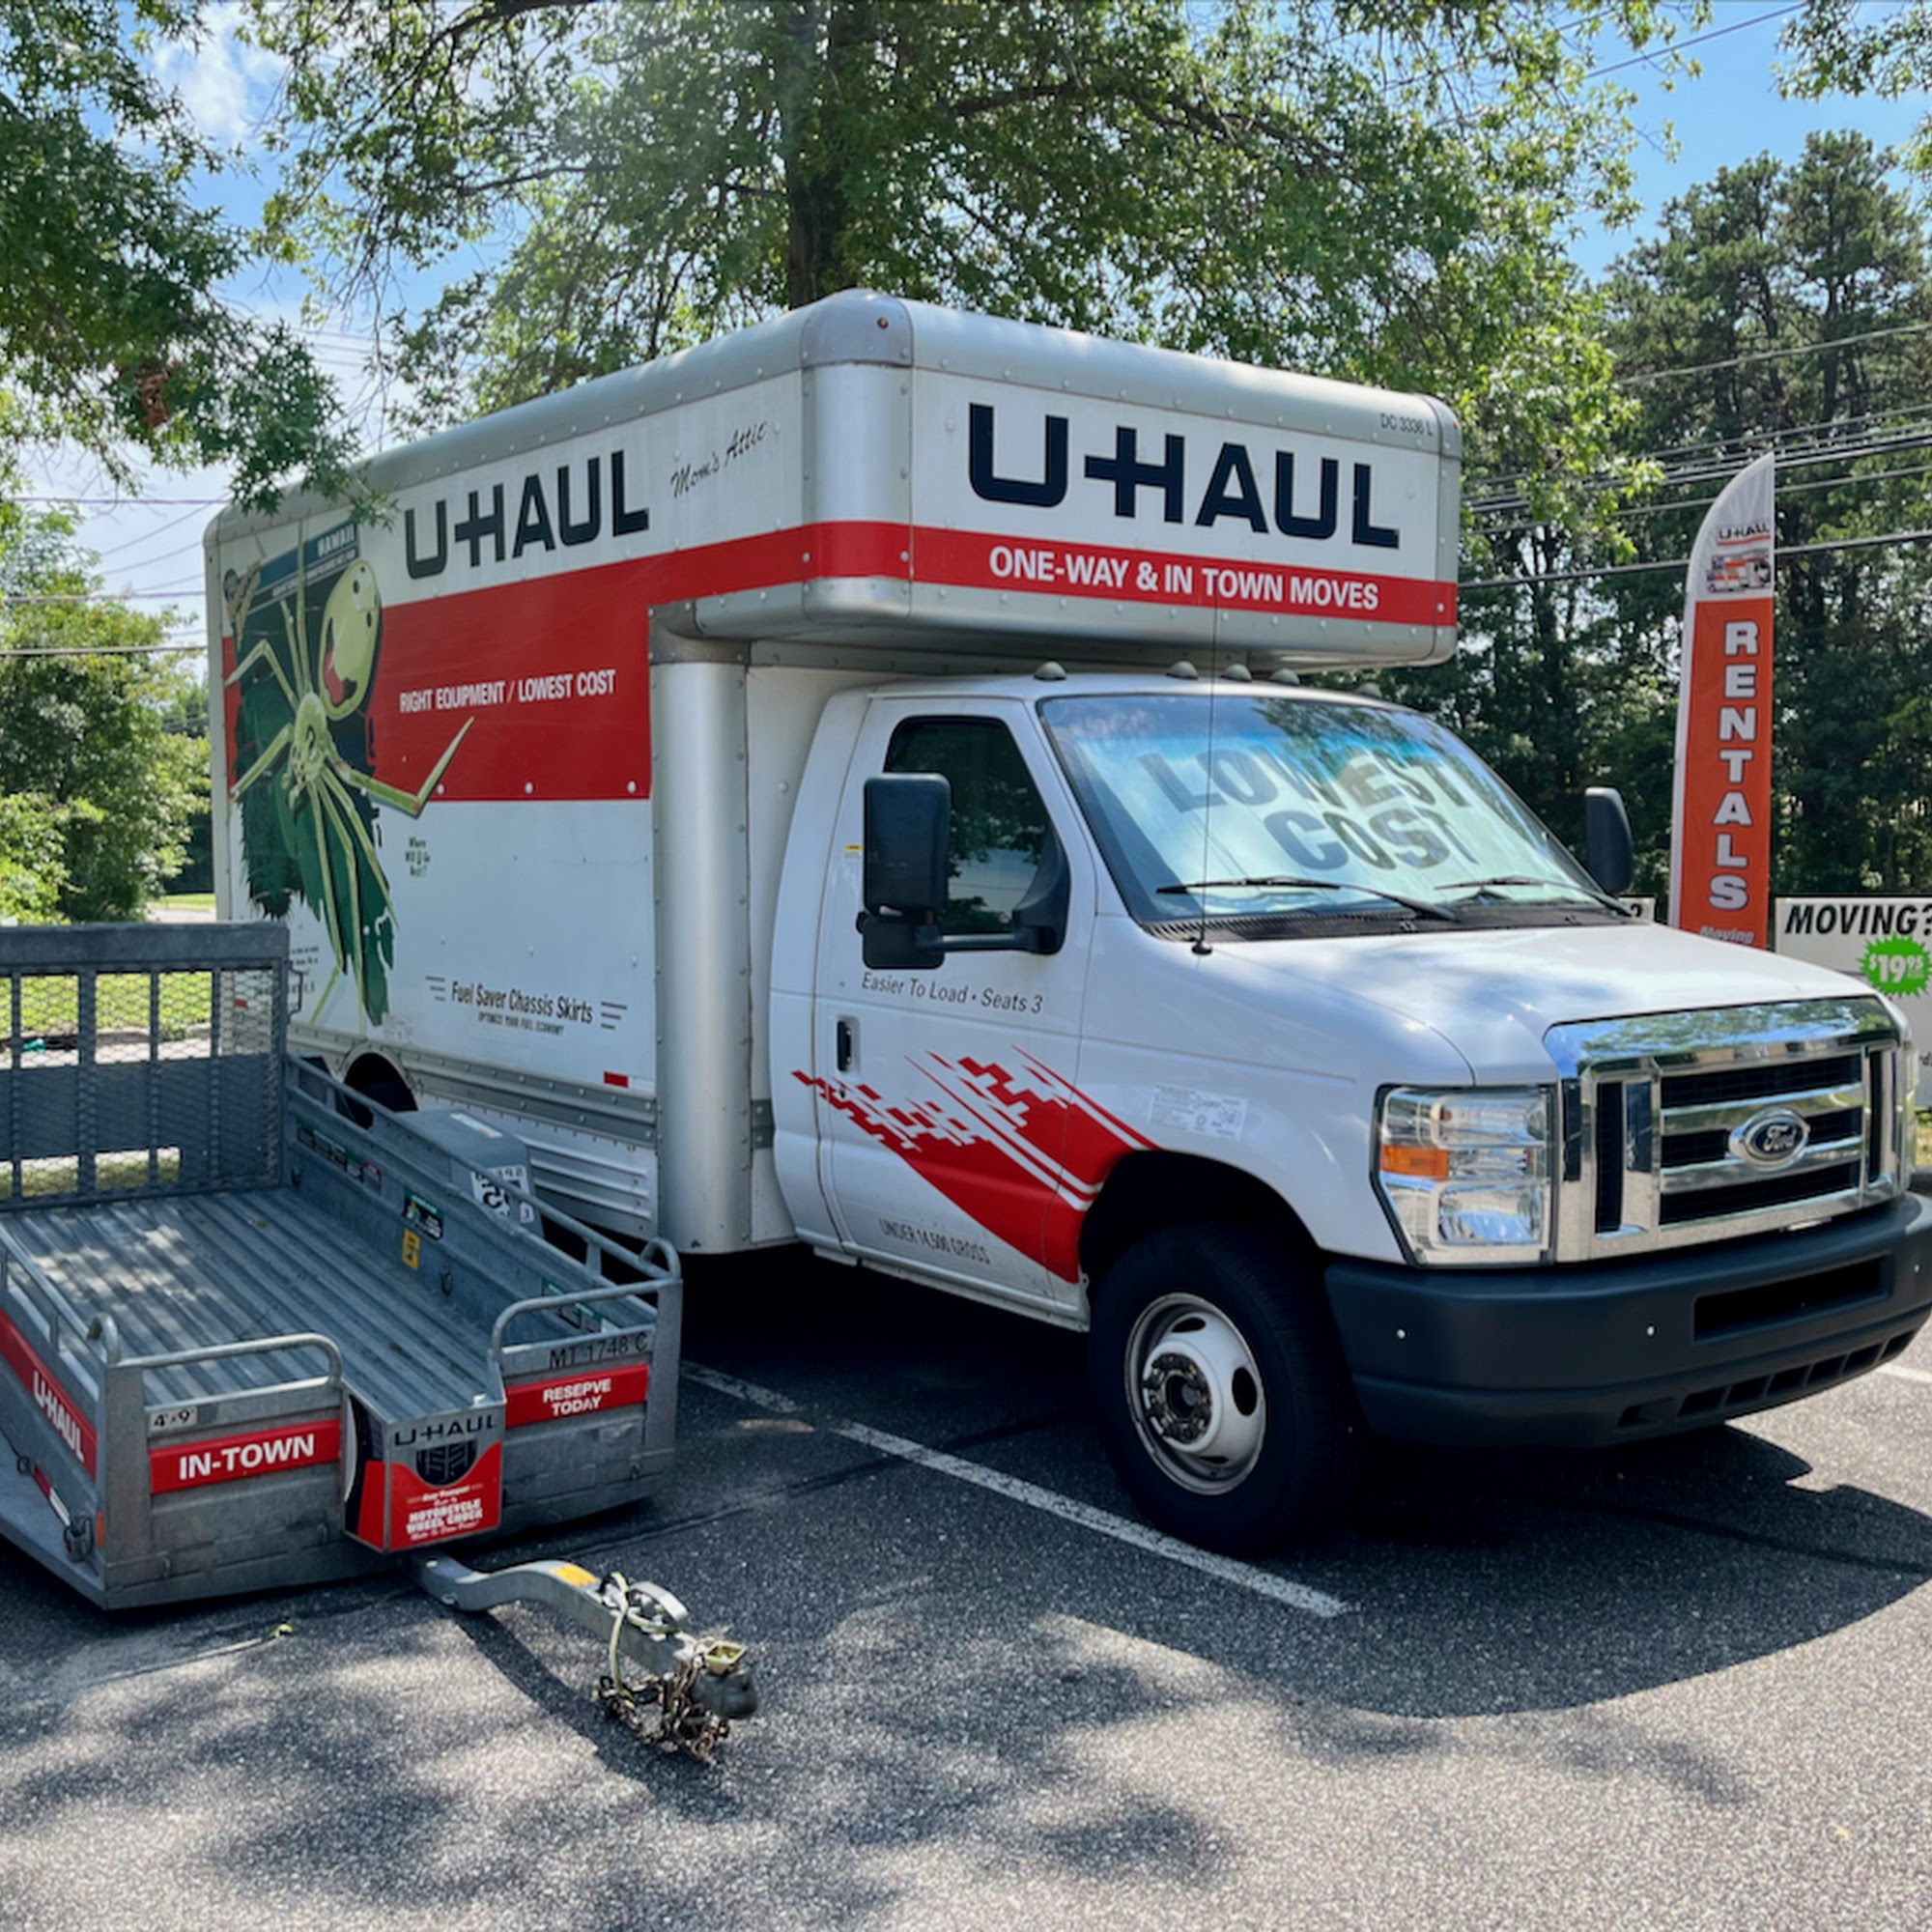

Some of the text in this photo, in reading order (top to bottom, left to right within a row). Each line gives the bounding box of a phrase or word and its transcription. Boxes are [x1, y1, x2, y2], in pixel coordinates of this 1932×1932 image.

[1379, 412, 1398, 431] DC
[1426, 419, 1435, 437] L
[670, 421, 768, 498] Mom's Attic
[988, 546, 1380, 611] ONE-WAY & IN TOWN MOVES
[399, 689, 433, 713] RIGHT
[436, 680, 505, 709] EQUIPMENT
[518, 672, 574, 703] LOWEST
[576, 668, 616, 696] COST
[1709, 620, 1759, 911] RENTALS
[1784, 903, 1932, 936] MOVING?
[451, 980, 593, 1024] Fuel Saver Chassis Skirts
[862, 971, 1044, 1014] Easier To Load Seats 3
[1763, 1124, 1799, 1151] Ford
[878, 1218, 918, 1245] UNDER
[950, 1237, 991, 1264] GROSS
[550, 1346, 577, 1370] MT
[635, 1331, 649, 1352] C
[543, 1378, 611, 1404] RESERVE
[551, 1395, 603, 1417] TODAY
[179, 1434, 315, 1481] IN-TOWN
